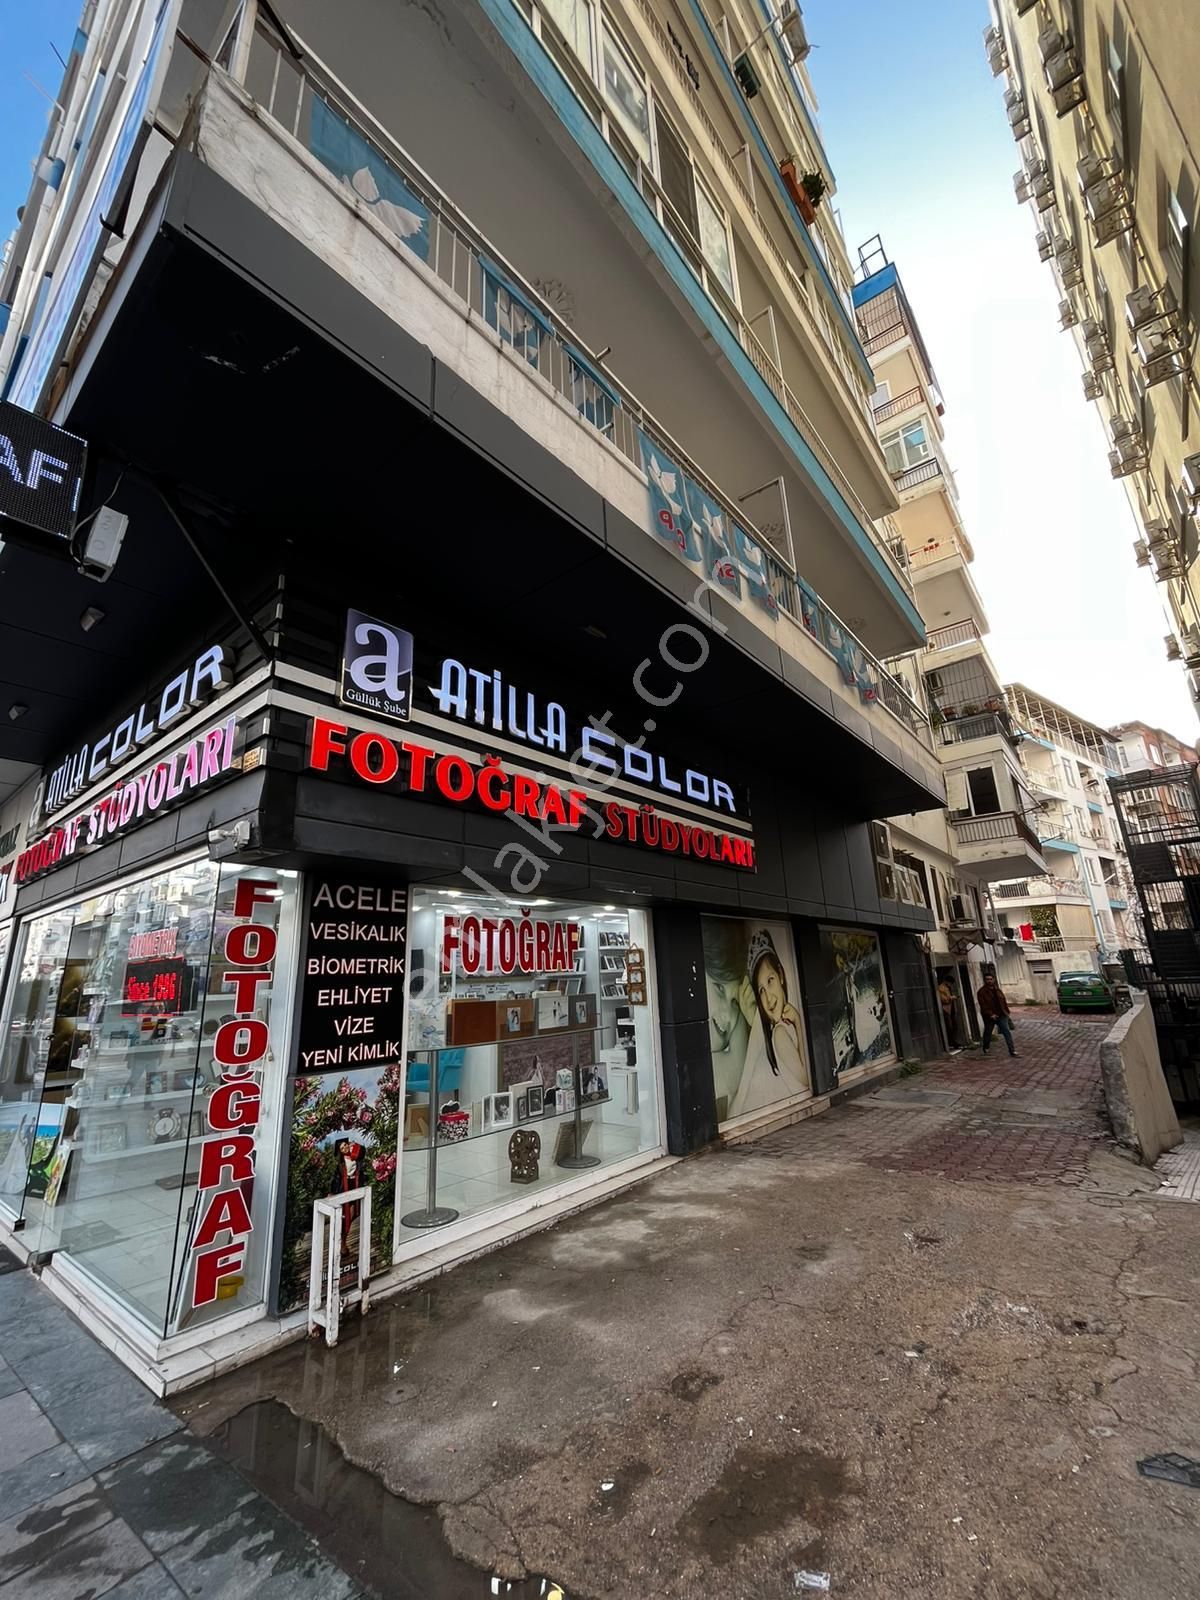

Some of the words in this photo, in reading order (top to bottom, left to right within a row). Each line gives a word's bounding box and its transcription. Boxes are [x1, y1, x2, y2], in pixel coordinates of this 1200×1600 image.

[350, 623, 405, 701] a
[88, 644, 225, 782] COLOR
[346, 688, 381, 709] Güllük
[383, 700, 407, 716] Şube
[427, 658, 566, 753] ATİLLA
[582, 726, 737, 813] COLOR
[86, 713, 237, 846] STÜDYOLARI
[310, 715, 588, 829] FOTOĞRAF
[605, 803, 754, 868] STÜDYOLARI
[313, 883, 407, 912] ACELE
[310, 921, 406, 942] VESİKALIK
[440, 907, 581, 976] FOTOĞRAF
[307, 955, 405, 975] BİOMETRİK
[317, 984, 393, 1006] EHLİYET
[334, 1016, 375, 1036] VİZE
[302, 1045, 343, 1067] YENİ
[348, 1039, 400, 1062] KİMLİK
[192, 877, 277, 1308] FOTOĞRAF
